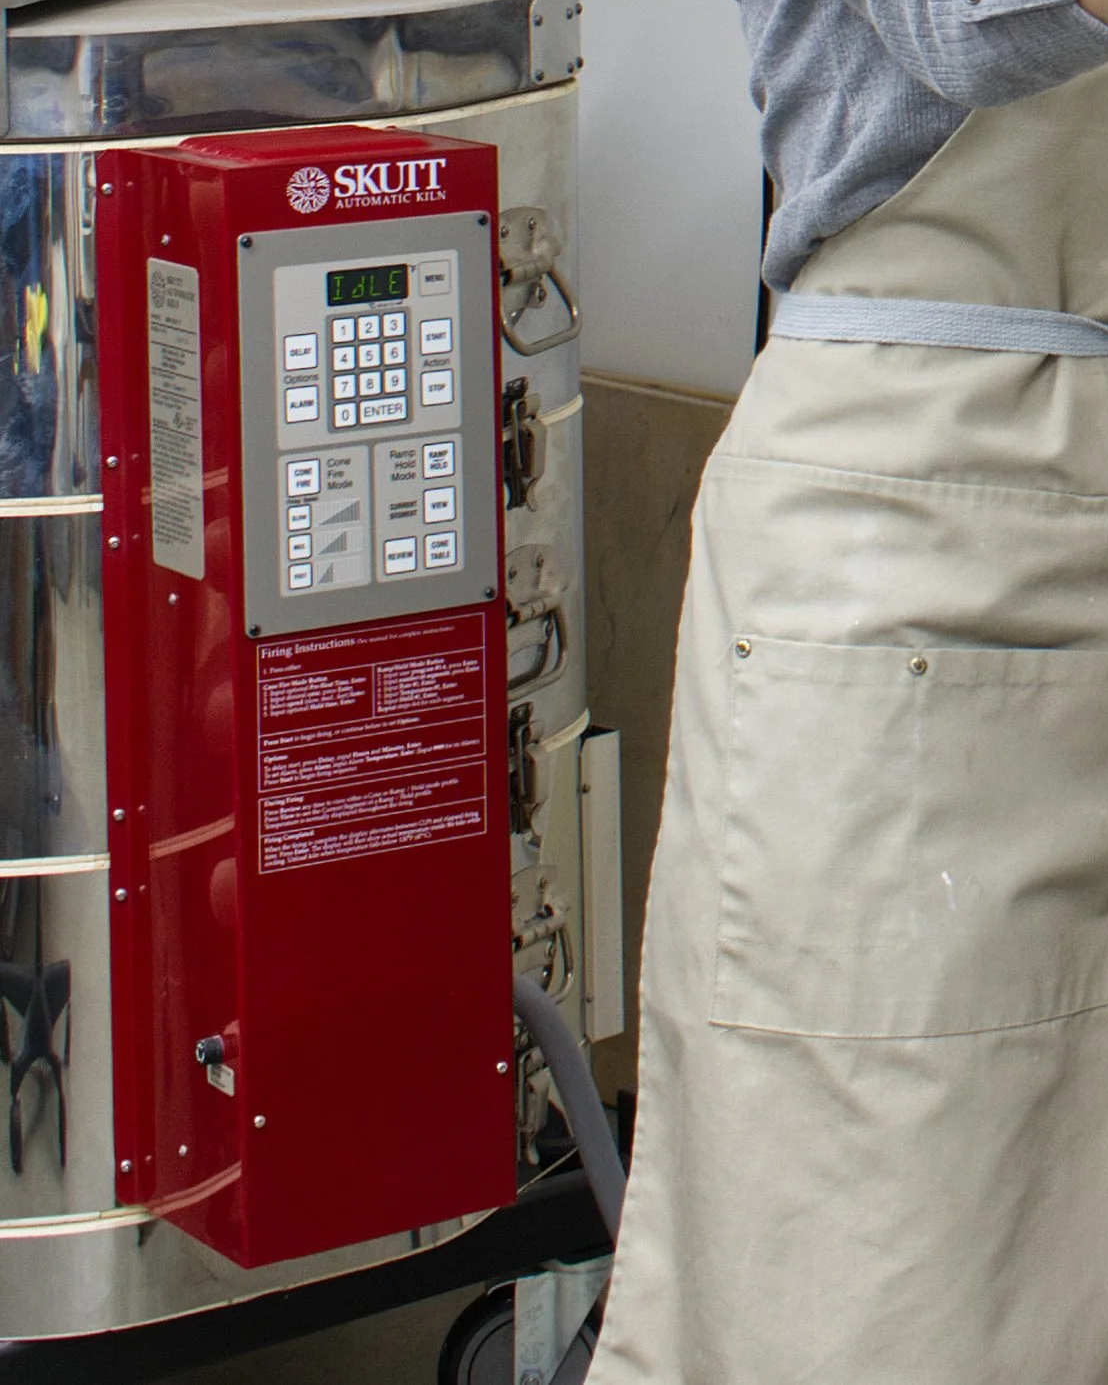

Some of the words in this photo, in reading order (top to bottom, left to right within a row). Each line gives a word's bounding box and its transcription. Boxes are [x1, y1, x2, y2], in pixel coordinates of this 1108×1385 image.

[334, 158, 447, 198] SKUTT
[335, 193, 412, 210] AUTOMATIC
[416, 190, 447, 202] KILN
[341, 325, 346, 335] 1
[365, 323, 372, 333] 2
[390, 319, 398, 331] 3
[426, 331, 447, 341] START
[365, 351, 373, 361] 5
[391, 347, 398, 359] 6
[340, 353, 348, 364] 4
[423, 357, 450, 368] Action
[284, 373, 320, 385] Options
[366, 378, 374, 389] 8
[392, 375, 399, 387] 9
[342, 381, 348, 392] 7
[428, 383, 447, 393] STOP
[290, 399, 314, 409] ALARM
[342, 409, 350, 421] 0
[364, 404, 403, 419] ENTER
[390, 449, 416, 459] Ramp
[428, 449, 448, 459] RAMP
[327, 457, 352, 468] Cone
[395, 460, 416, 469] Hold
[430, 461, 448, 470] HOLD
[294, 467, 312, 477] CONE
[328, 470, 344, 479] Fire
[392, 472, 416, 482] Mode
[296, 479, 312, 489] FIRE
[328, 480, 353, 490] Mode
[431, 501, 448, 510] VIEW
[431, 539, 448, 549] CONE
[388, 551, 414, 561] REVIEW
[430, 551, 450, 561] TABLE
[261, 644, 292, 662] Firing
[295, 635, 354, 653] Instructions
